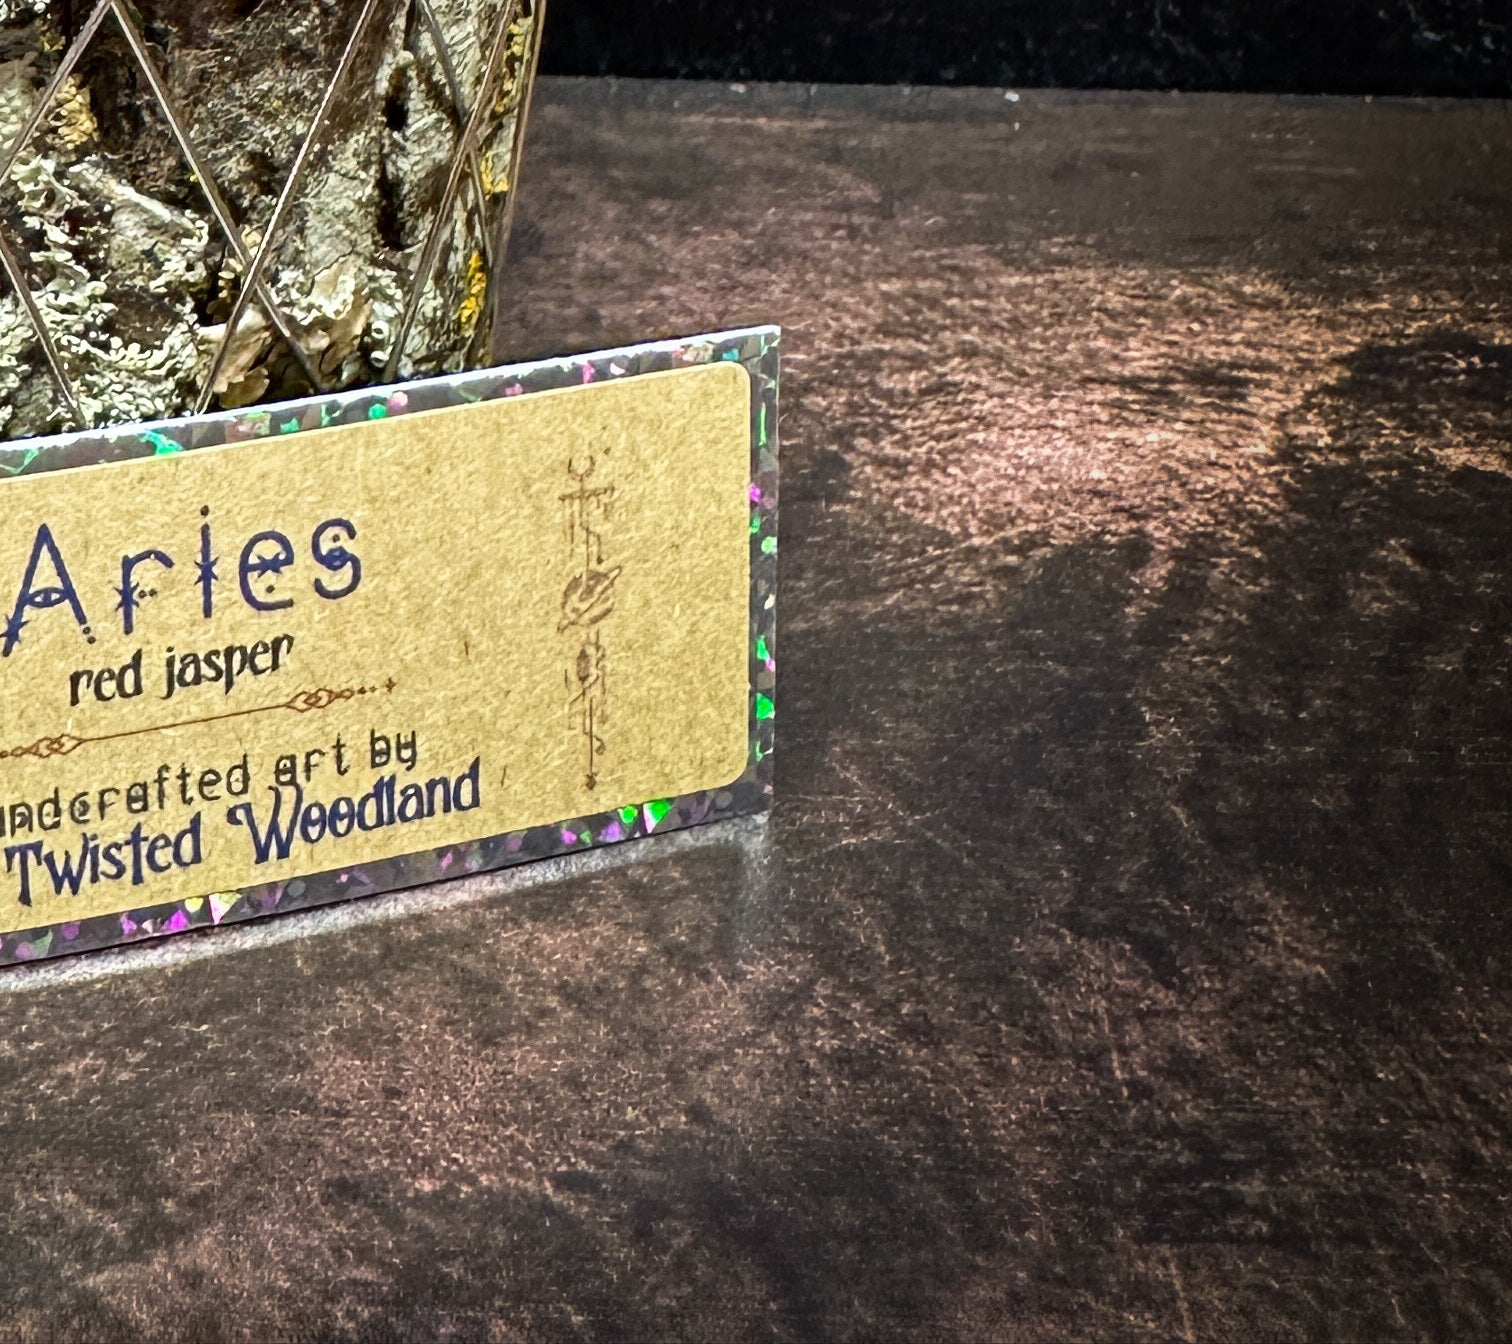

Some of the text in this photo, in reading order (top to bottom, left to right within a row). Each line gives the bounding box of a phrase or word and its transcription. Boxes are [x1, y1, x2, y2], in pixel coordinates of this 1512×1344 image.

[69, 632, 295, 706] red jasper
[274, 732, 349, 786] art
[371, 728, 418, 772] by
[4, 811, 202, 908] Twisted
[226, 755, 481, 865] Woodland
